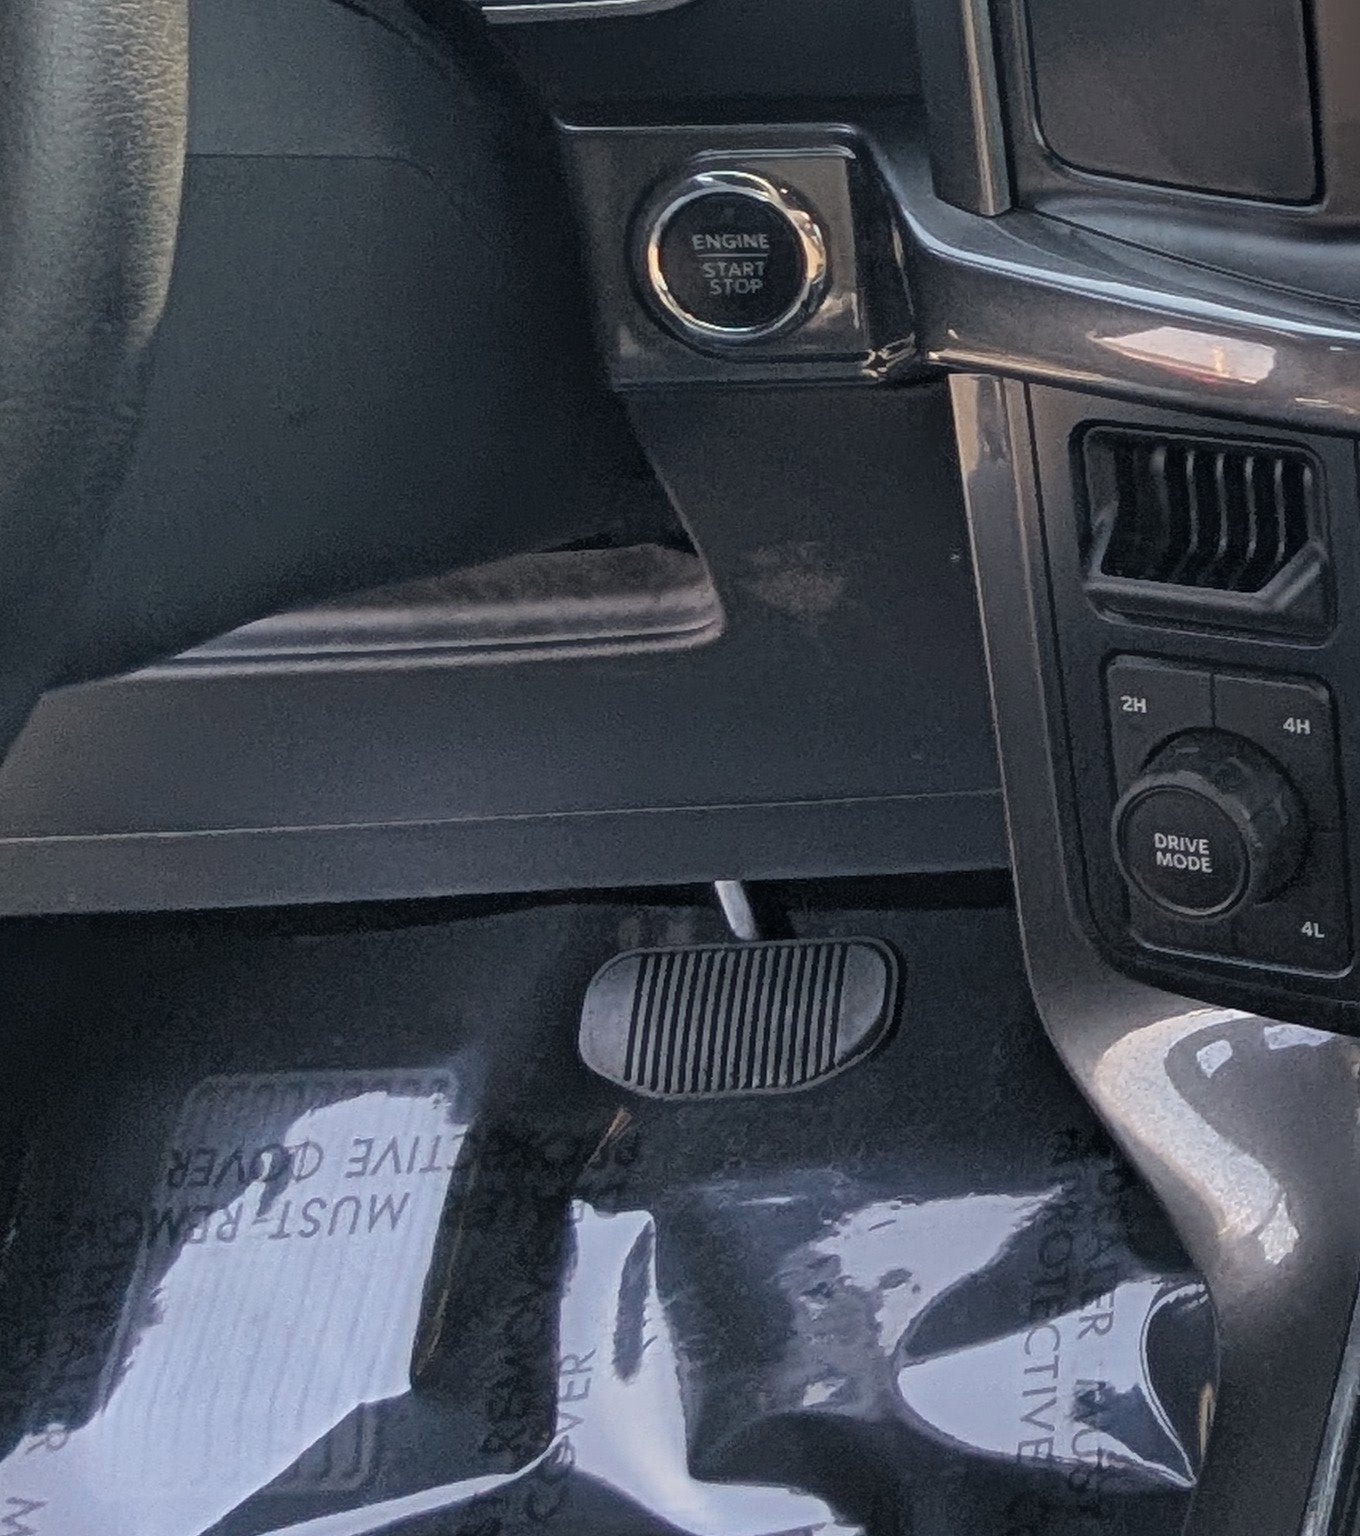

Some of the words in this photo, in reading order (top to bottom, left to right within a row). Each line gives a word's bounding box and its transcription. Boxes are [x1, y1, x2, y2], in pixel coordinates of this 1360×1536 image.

[692, 234, 769, 250] ENGINE
[701, 261, 765, 278] START
[710, 278, 762, 296] STOP
[1121, 696, 1146, 713] 2H
[1283, 718, 1310, 734] 4H
[1154, 833, 1209, 854] DRIVE
[1156, 852, 1212, 873] MODE
[1301, 922, 1324, 938] 4L
